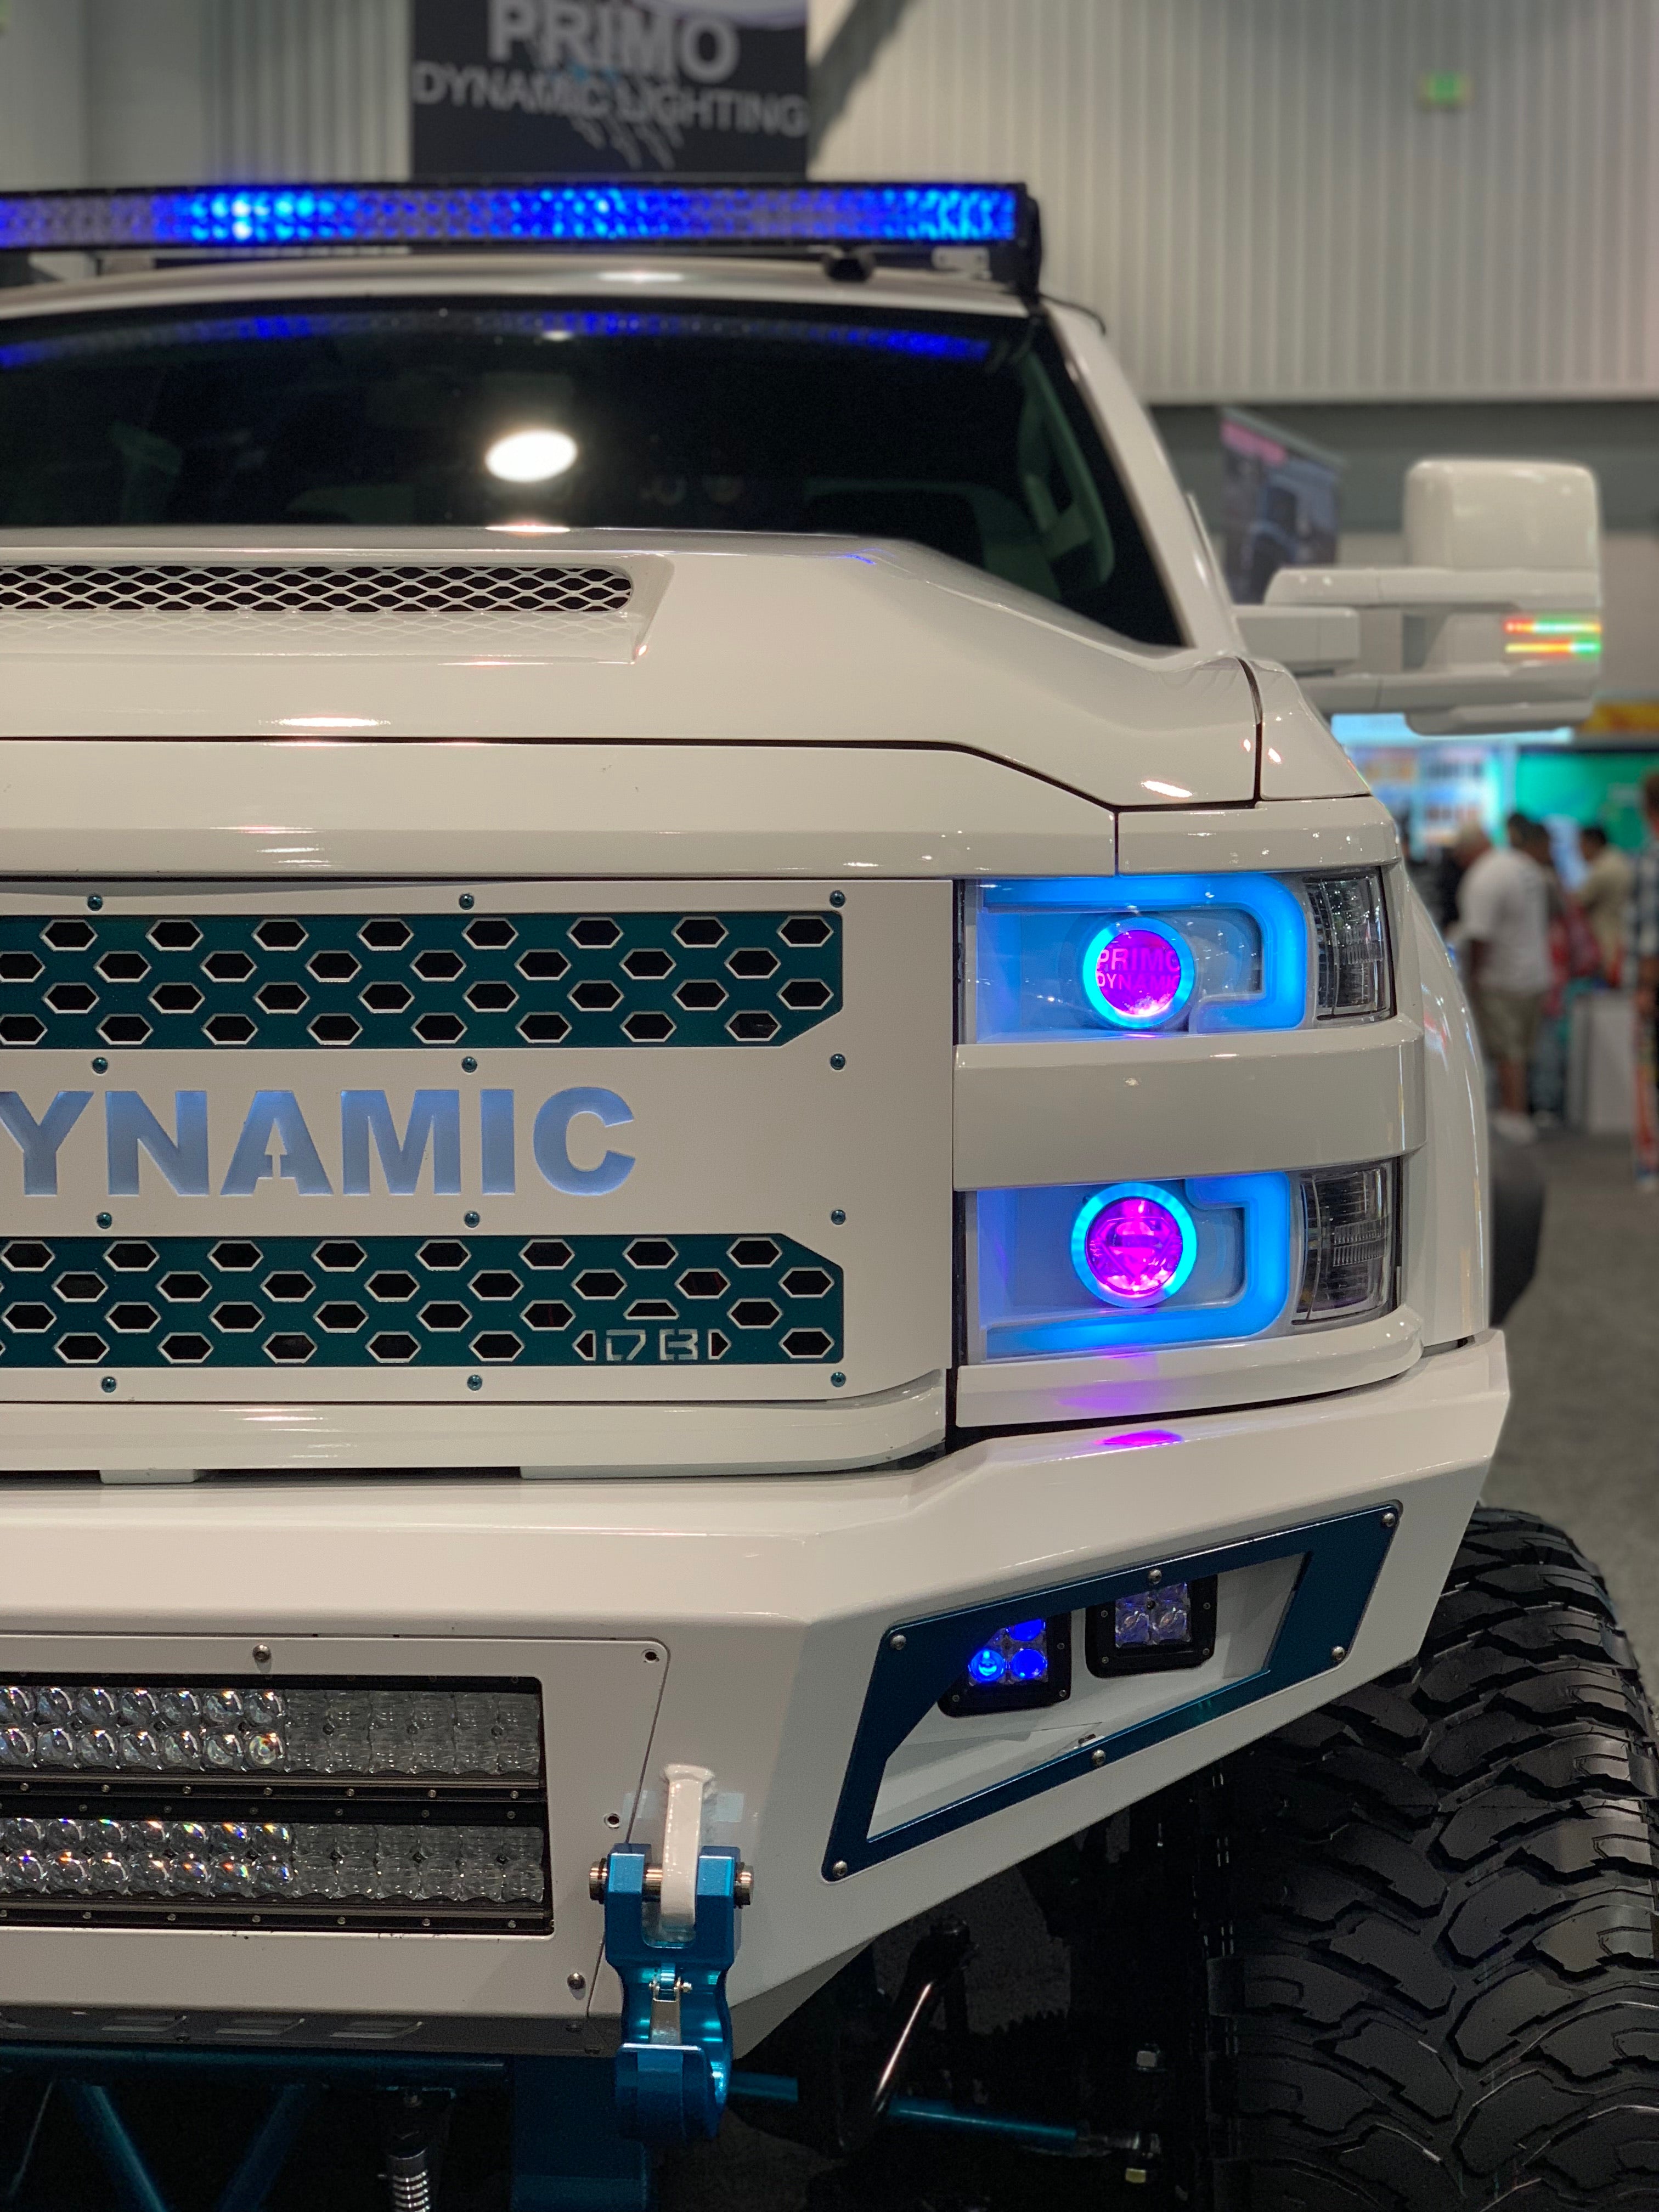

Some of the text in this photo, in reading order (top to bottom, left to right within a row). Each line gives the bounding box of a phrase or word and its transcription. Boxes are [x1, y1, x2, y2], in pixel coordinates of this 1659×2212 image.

[488, 0, 740, 83] PRIMO
[411, 61, 810, 138] DYNAMIC LIGHTING
[0, 1087, 636, 1195] YNAMIC
